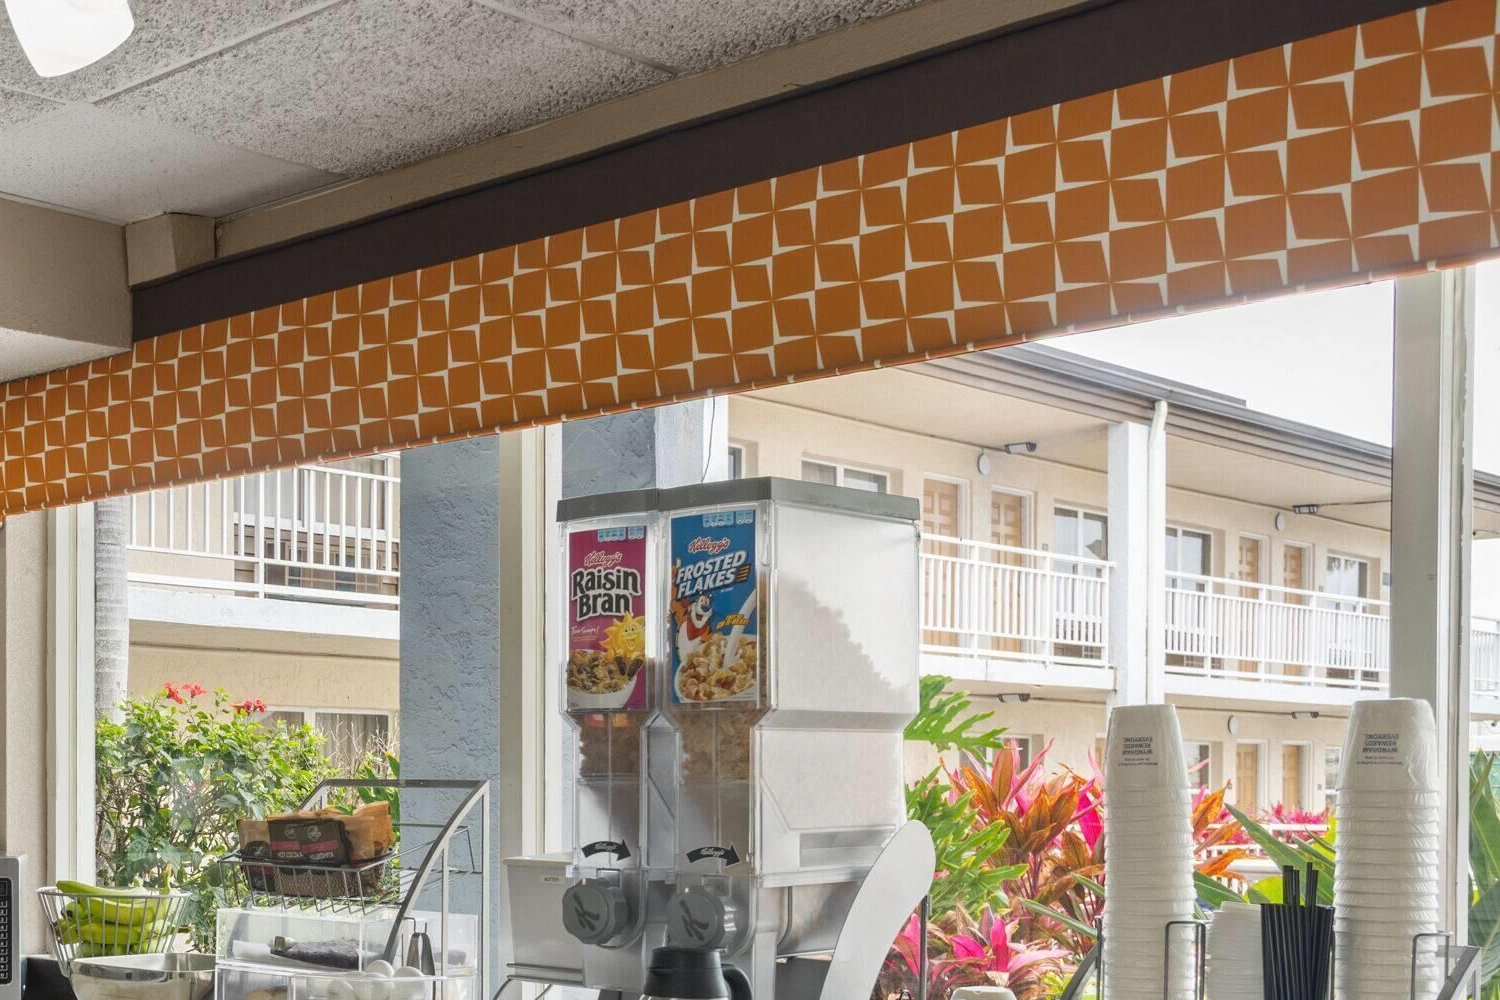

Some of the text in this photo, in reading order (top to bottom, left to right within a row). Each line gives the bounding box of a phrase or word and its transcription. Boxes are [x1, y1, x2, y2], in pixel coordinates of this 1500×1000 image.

[584, 550, 623, 567] Kellogg's
[688, 537, 731, 555] Kellogg's
[676, 550, 747, 585] FROSTED
[572, 567, 640, 599] Raisin
[677, 568, 737, 599] FLAKES
[578, 592, 632, 619] Bran
